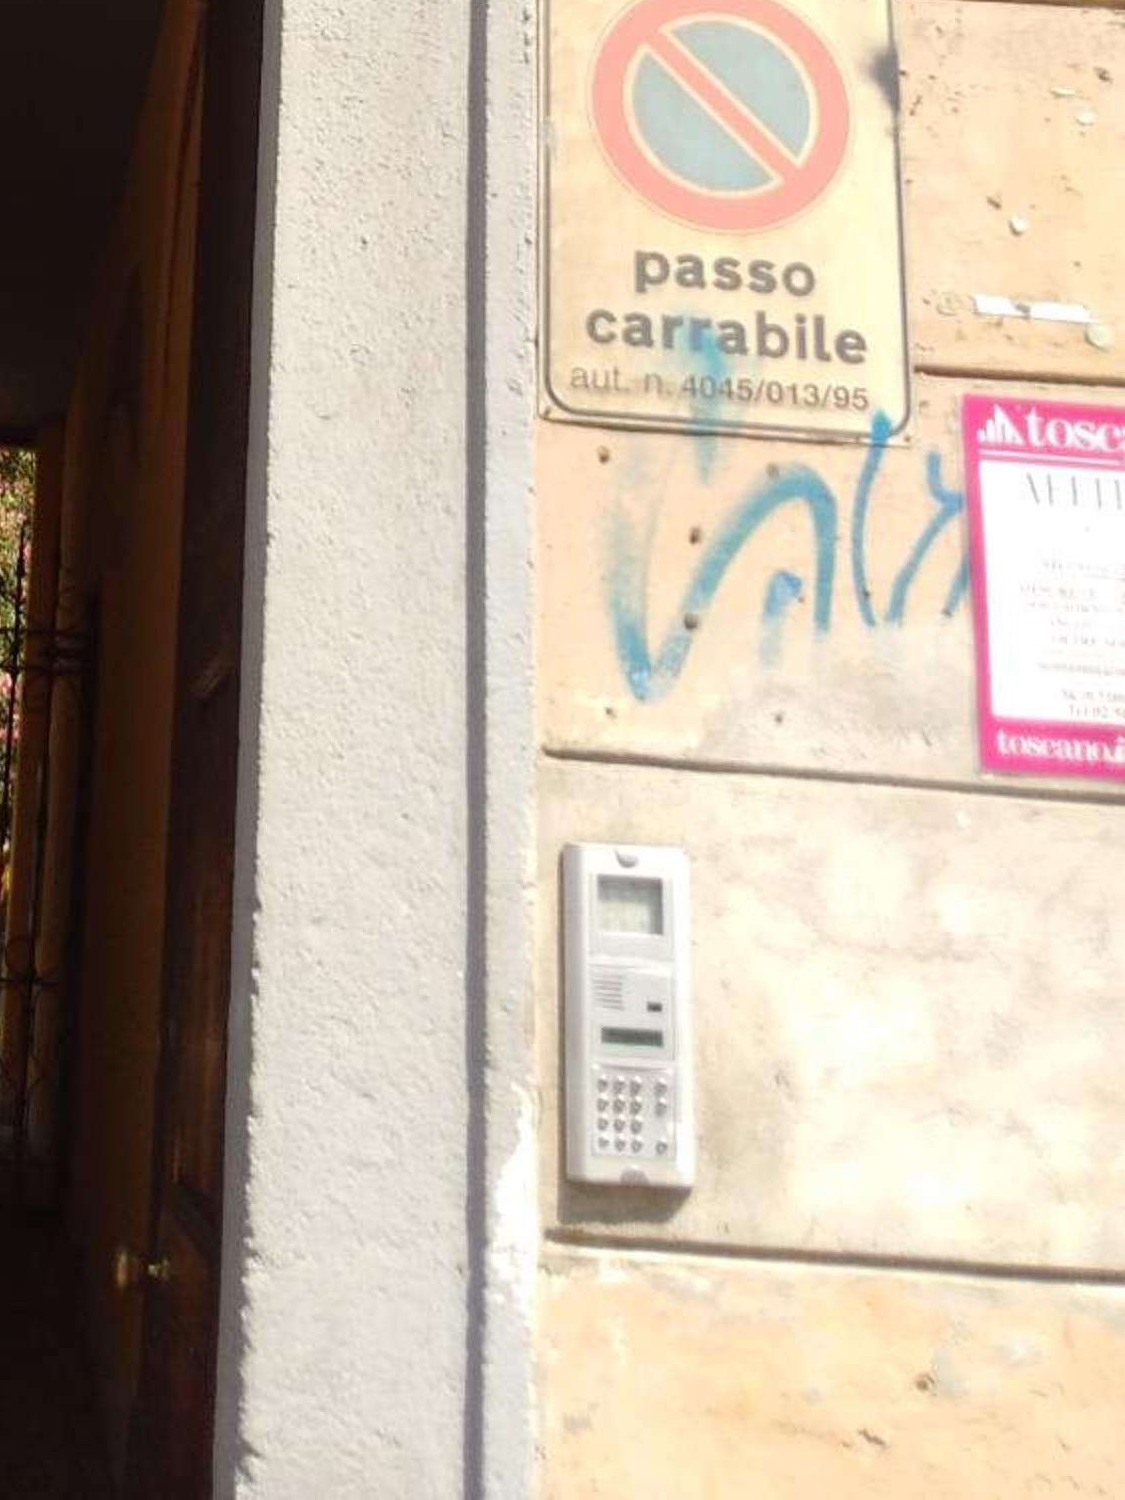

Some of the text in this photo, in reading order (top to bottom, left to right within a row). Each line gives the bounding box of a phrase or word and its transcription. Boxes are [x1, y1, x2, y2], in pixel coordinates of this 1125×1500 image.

[633, 249, 816, 298] passo
[585, 306, 868, 365] carrabile
[681, 374, 871, 412] 4045/013/95
